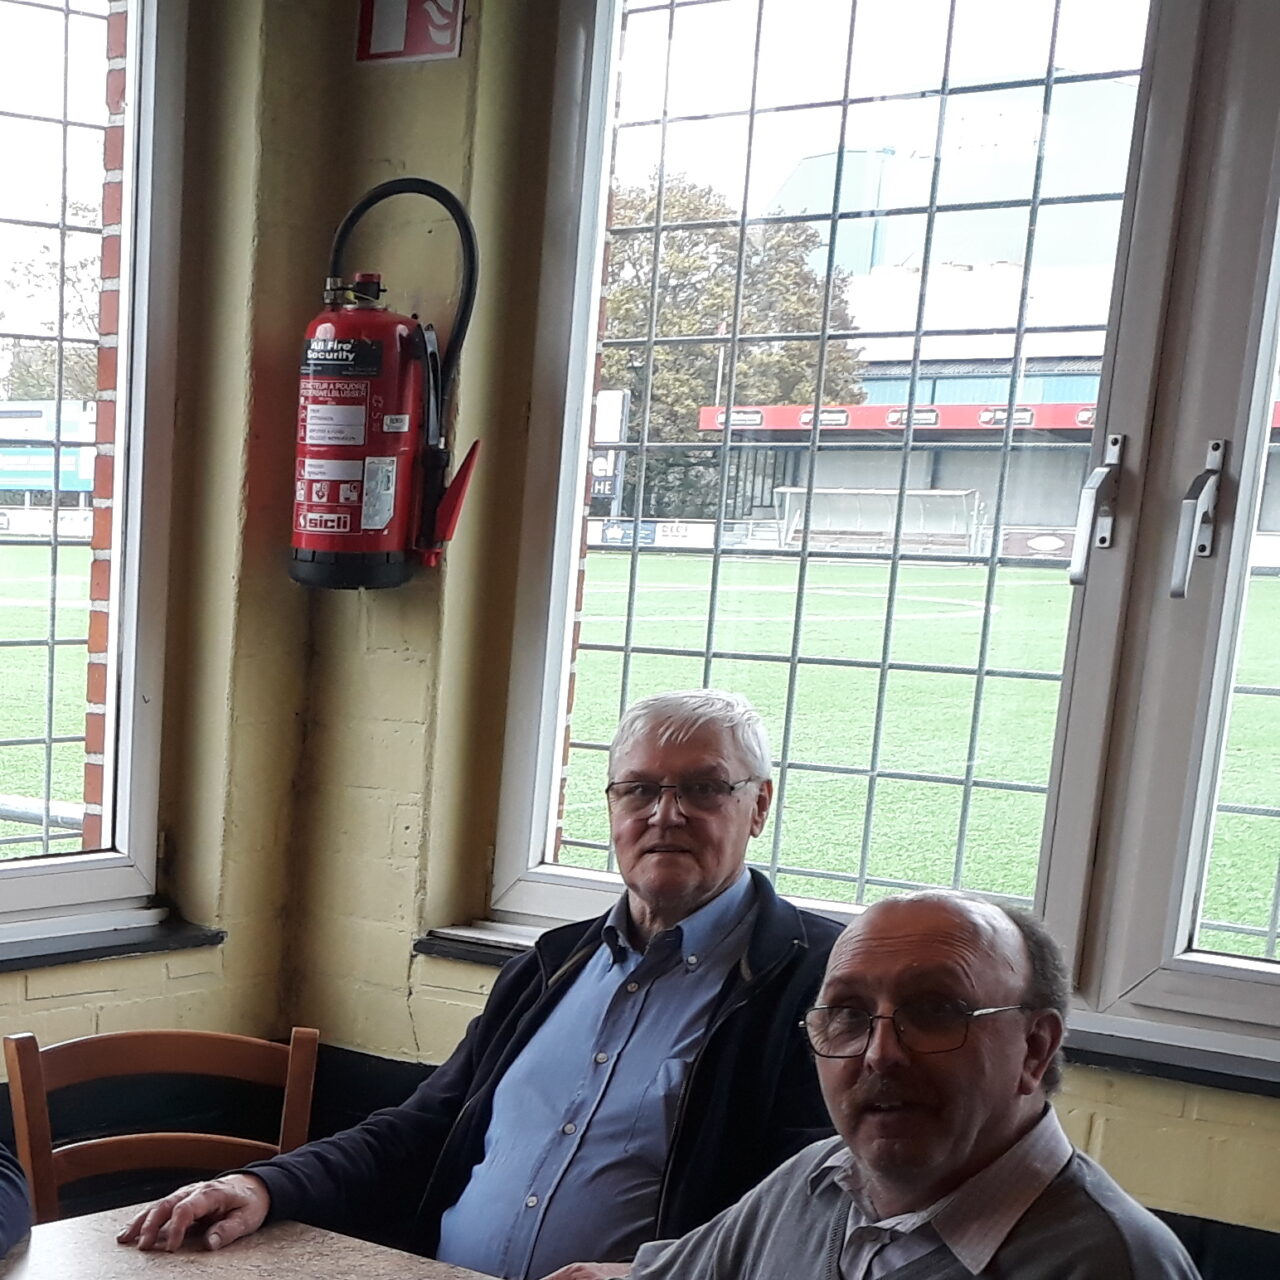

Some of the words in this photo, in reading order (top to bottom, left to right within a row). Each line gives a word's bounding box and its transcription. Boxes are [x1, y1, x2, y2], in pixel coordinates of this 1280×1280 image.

[311, 340, 324, 350] All
[327, 340, 352, 350] Fire
[307, 349, 355, 361] Security
[308, 515, 348, 529] sicli
